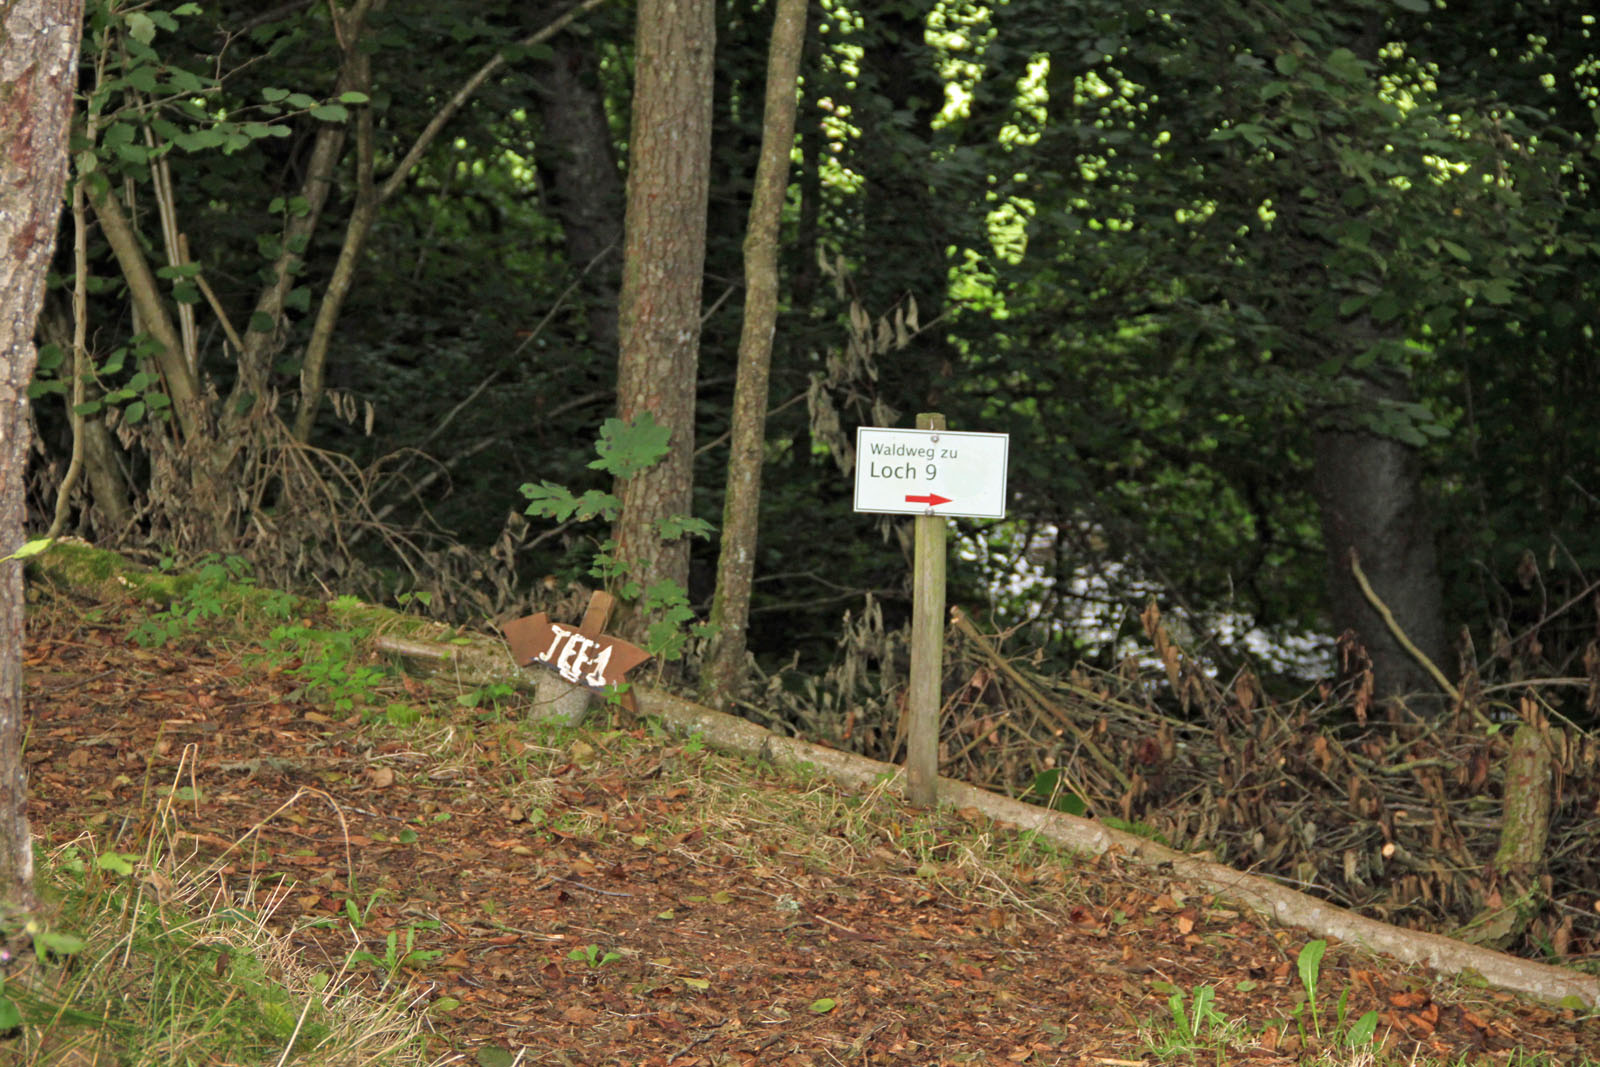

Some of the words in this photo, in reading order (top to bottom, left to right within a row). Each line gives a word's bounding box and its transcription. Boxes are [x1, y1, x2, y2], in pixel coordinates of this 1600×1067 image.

[870, 443, 935, 461] Waldweg
[940, 448, 958, 459] zu
[870, 461, 917, 480] Loch
[925, 463, 937, 481] 9
